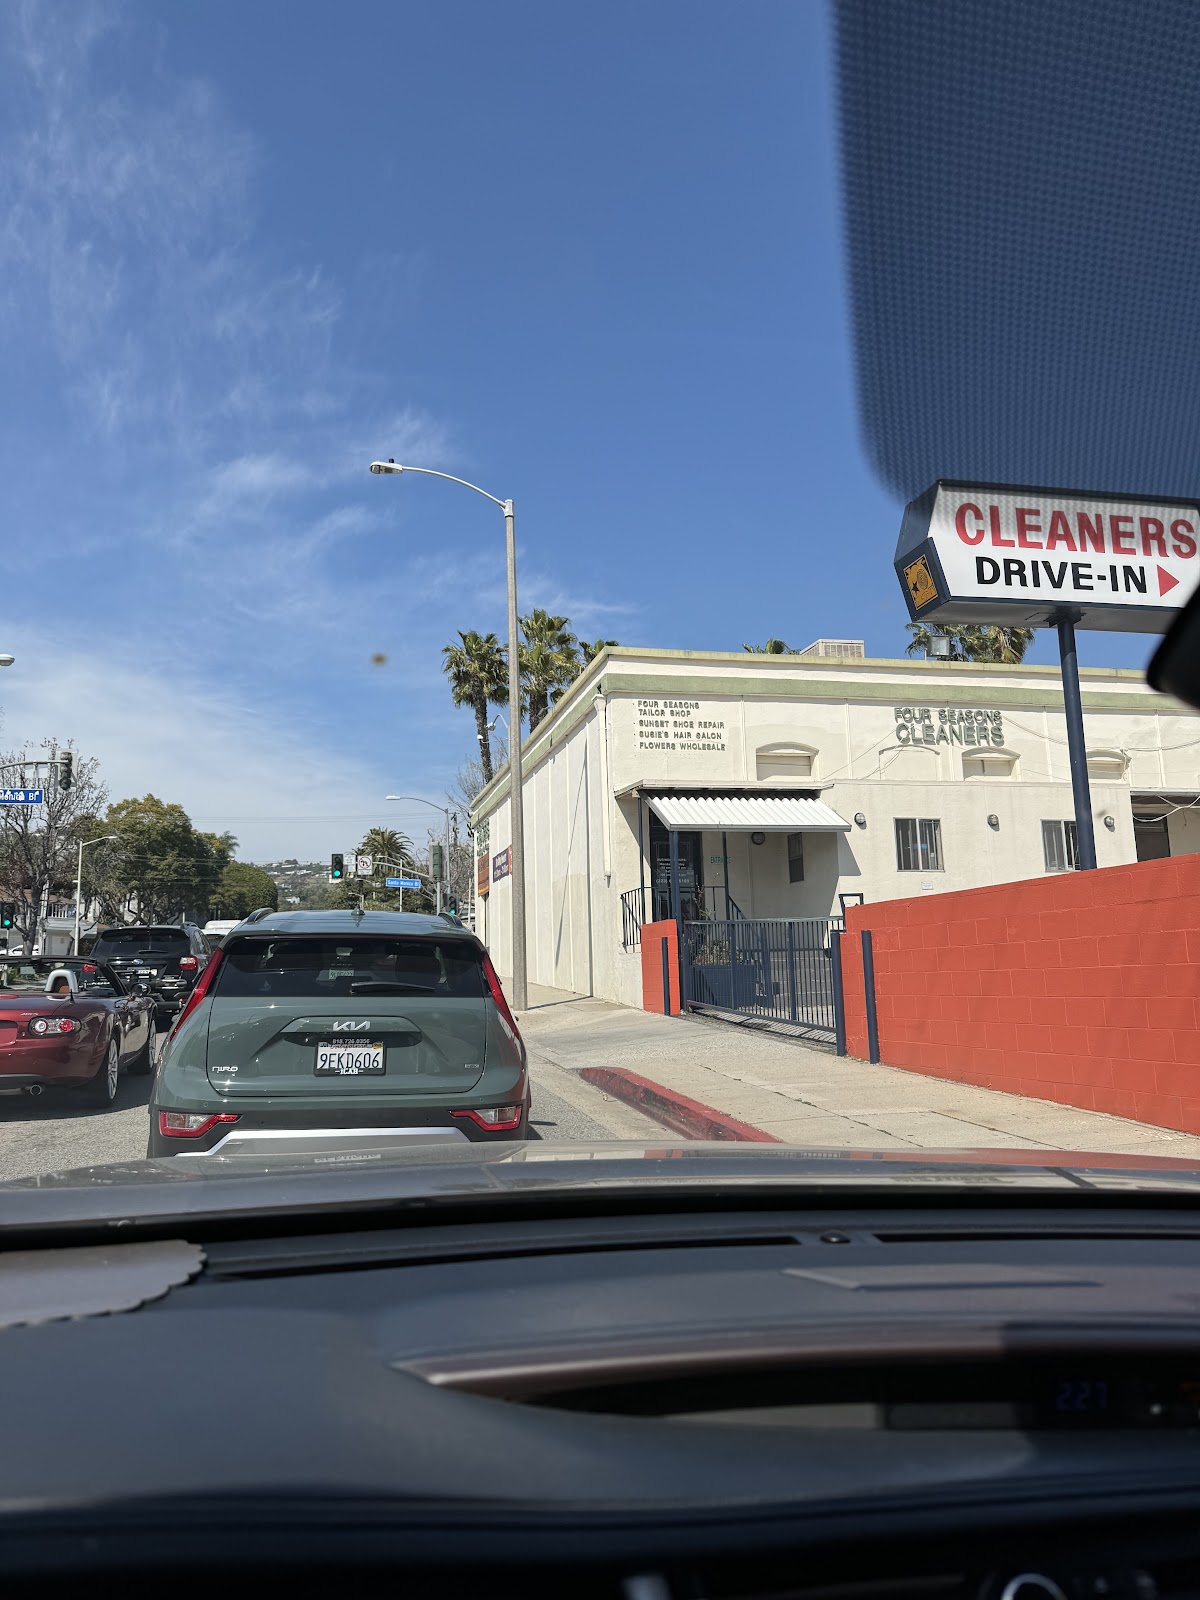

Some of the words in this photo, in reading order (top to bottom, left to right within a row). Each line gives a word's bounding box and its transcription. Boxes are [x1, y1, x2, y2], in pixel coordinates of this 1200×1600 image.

[955, 502, 1198, 559] CLEANERS
[975, 556, 1148, 593] DRIVE-IN
[638, 700, 659, 708] FOUR
[663, 701, 700, 710] SEASONS
[638, 708, 666, 717] TAILOR
[670, 710, 692, 718] SHOP
[894, 707, 932, 724] FOUR
[938, 708, 1003, 727] SEASONS
[638, 720, 670, 728] SUNSET
[673, 720, 694, 728] SHOE
[698, 721, 725, 730] REPAIR
[639, 730, 669, 738] SUSIE'S
[696, 732, 722, 740] SALON
[895, 723, 1005, 747] CLEANERS
[640, 742, 676, 750] FLOWERS
[680, 742, 726, 751] WHOLESALE
[332, 1020, 370, 1031] KIA
[320, 1052, 381, 1069] 9EKD606
